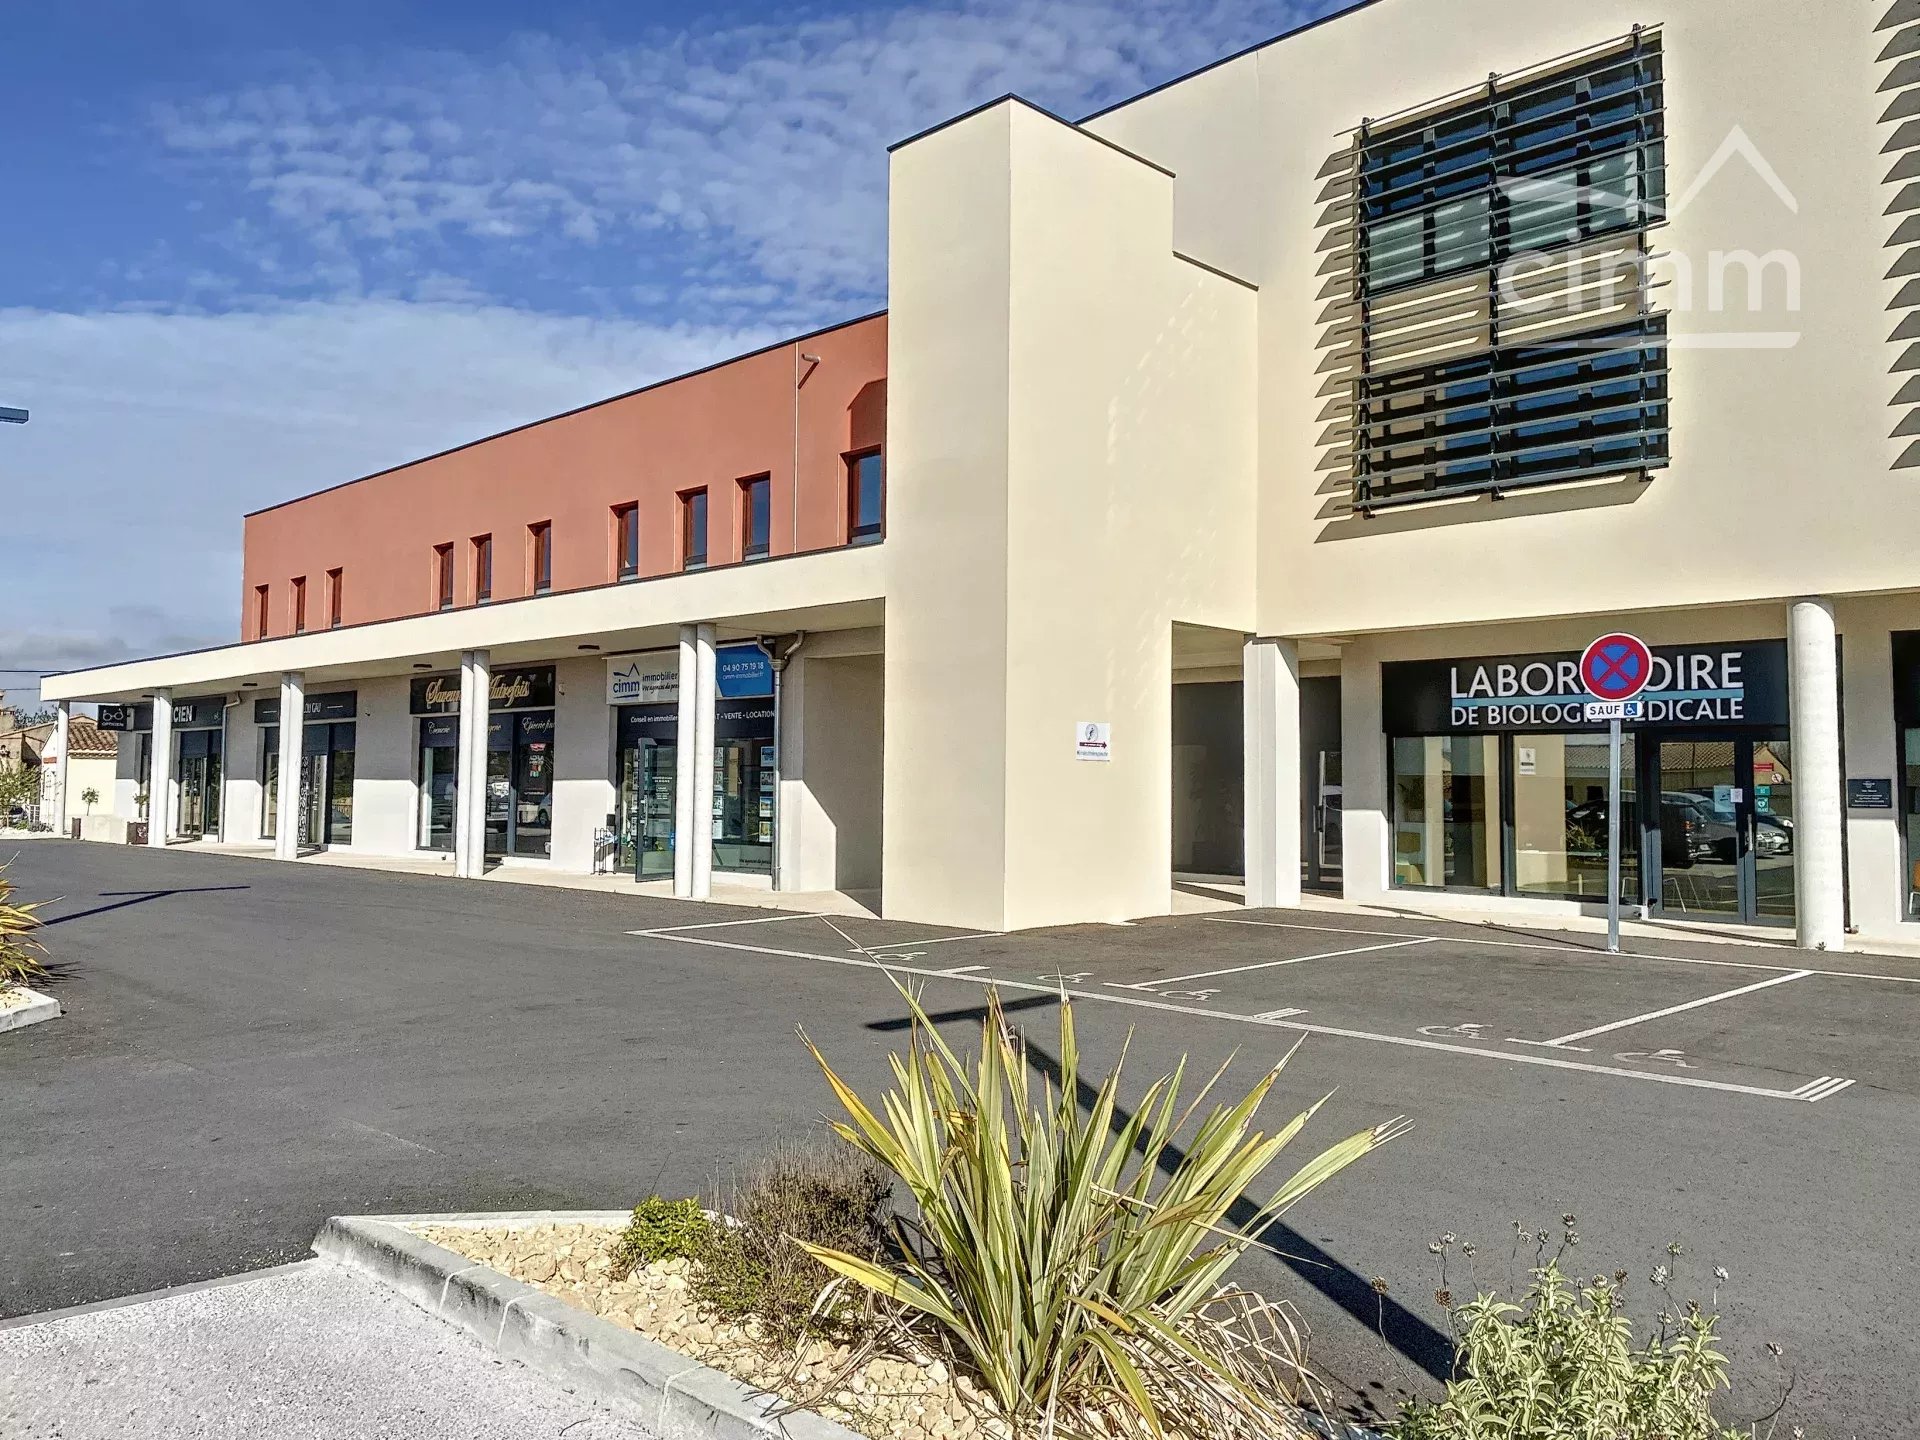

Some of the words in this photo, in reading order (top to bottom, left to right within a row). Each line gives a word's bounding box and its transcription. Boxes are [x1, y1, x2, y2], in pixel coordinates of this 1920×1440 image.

[722, 664, 731, 672] 04
[732, 663, 740, 672] 90
[741, 662, 749, 671] 75
[750, 662, 757, 670] 19
[642, 671, 678, 682] immobilier
[1451, 652, 1744, 699] LABOROIRE
[613, 679, 640, 693] cimm
[172, 704, 193, 723] CIEN
[724, 712, 742, 720] VENTE
[746, 710, 775, 719] LOCATION
[1451, 706, 1479, 726] DE
[1487, 702, 1602, 725] BIOLOGI
[1626, 696, 1744, 722] DICALE
[1590, 705, 1621, 715] SAUF
